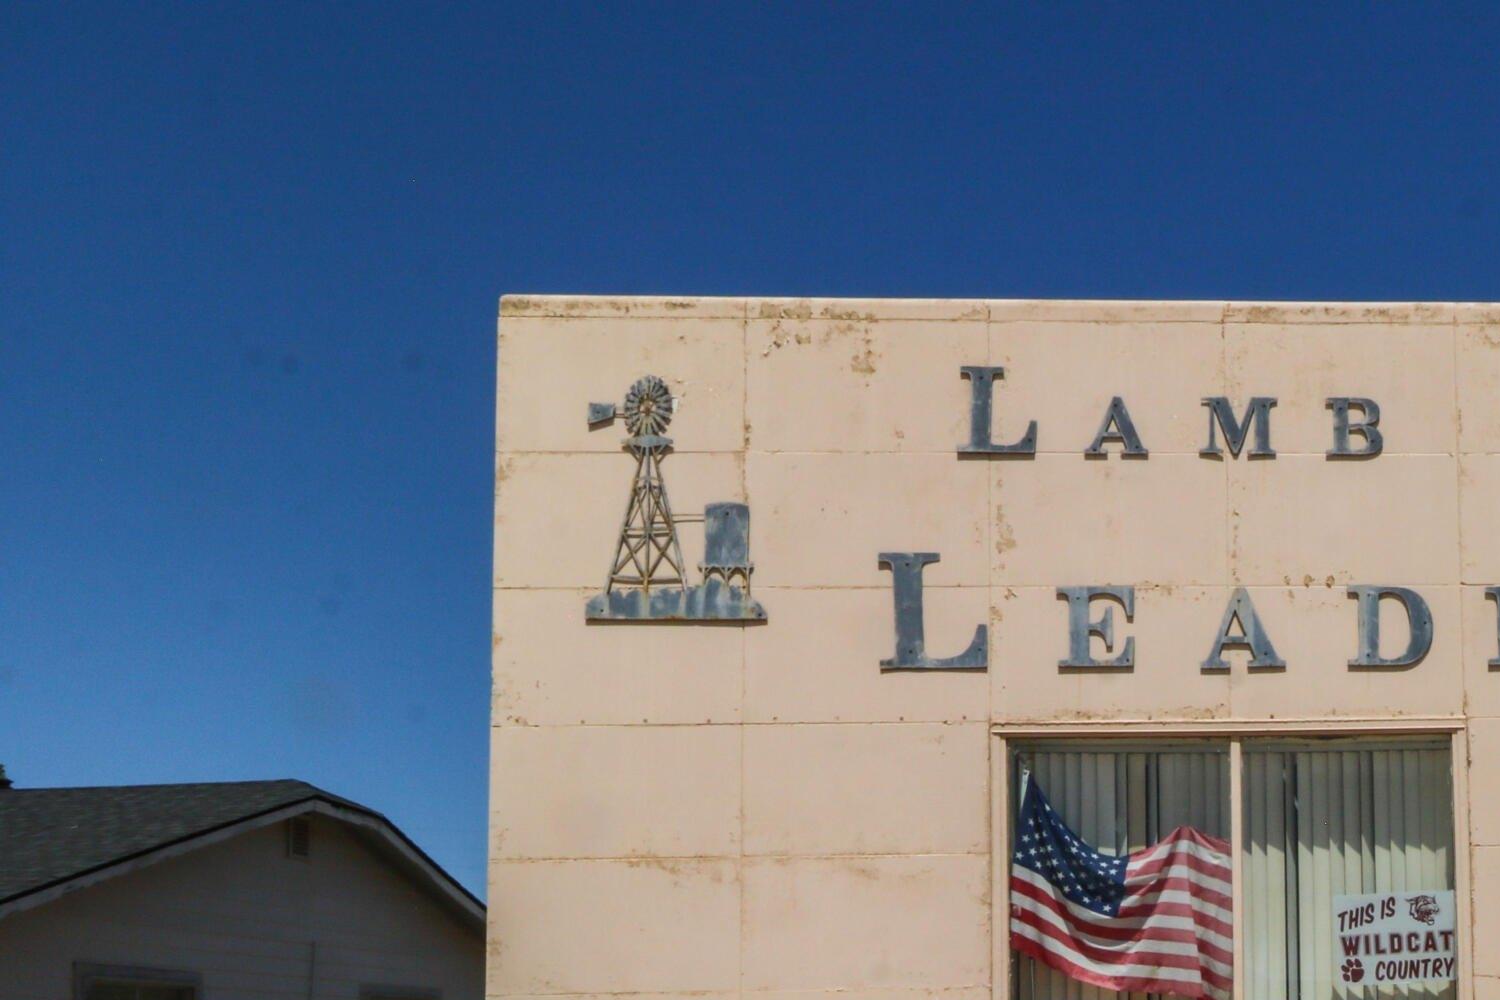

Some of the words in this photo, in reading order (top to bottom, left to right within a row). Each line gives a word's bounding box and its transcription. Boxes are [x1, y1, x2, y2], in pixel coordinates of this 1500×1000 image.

[957, 366, 1383, 460] LAMB
[1338, 902, 1375, 932] THIS
[1380, 896, 1396, 920] IS
[1341, 930, 1454, 957] WILDCAT
[1375, 957, 1455, 981] COUNTRY
